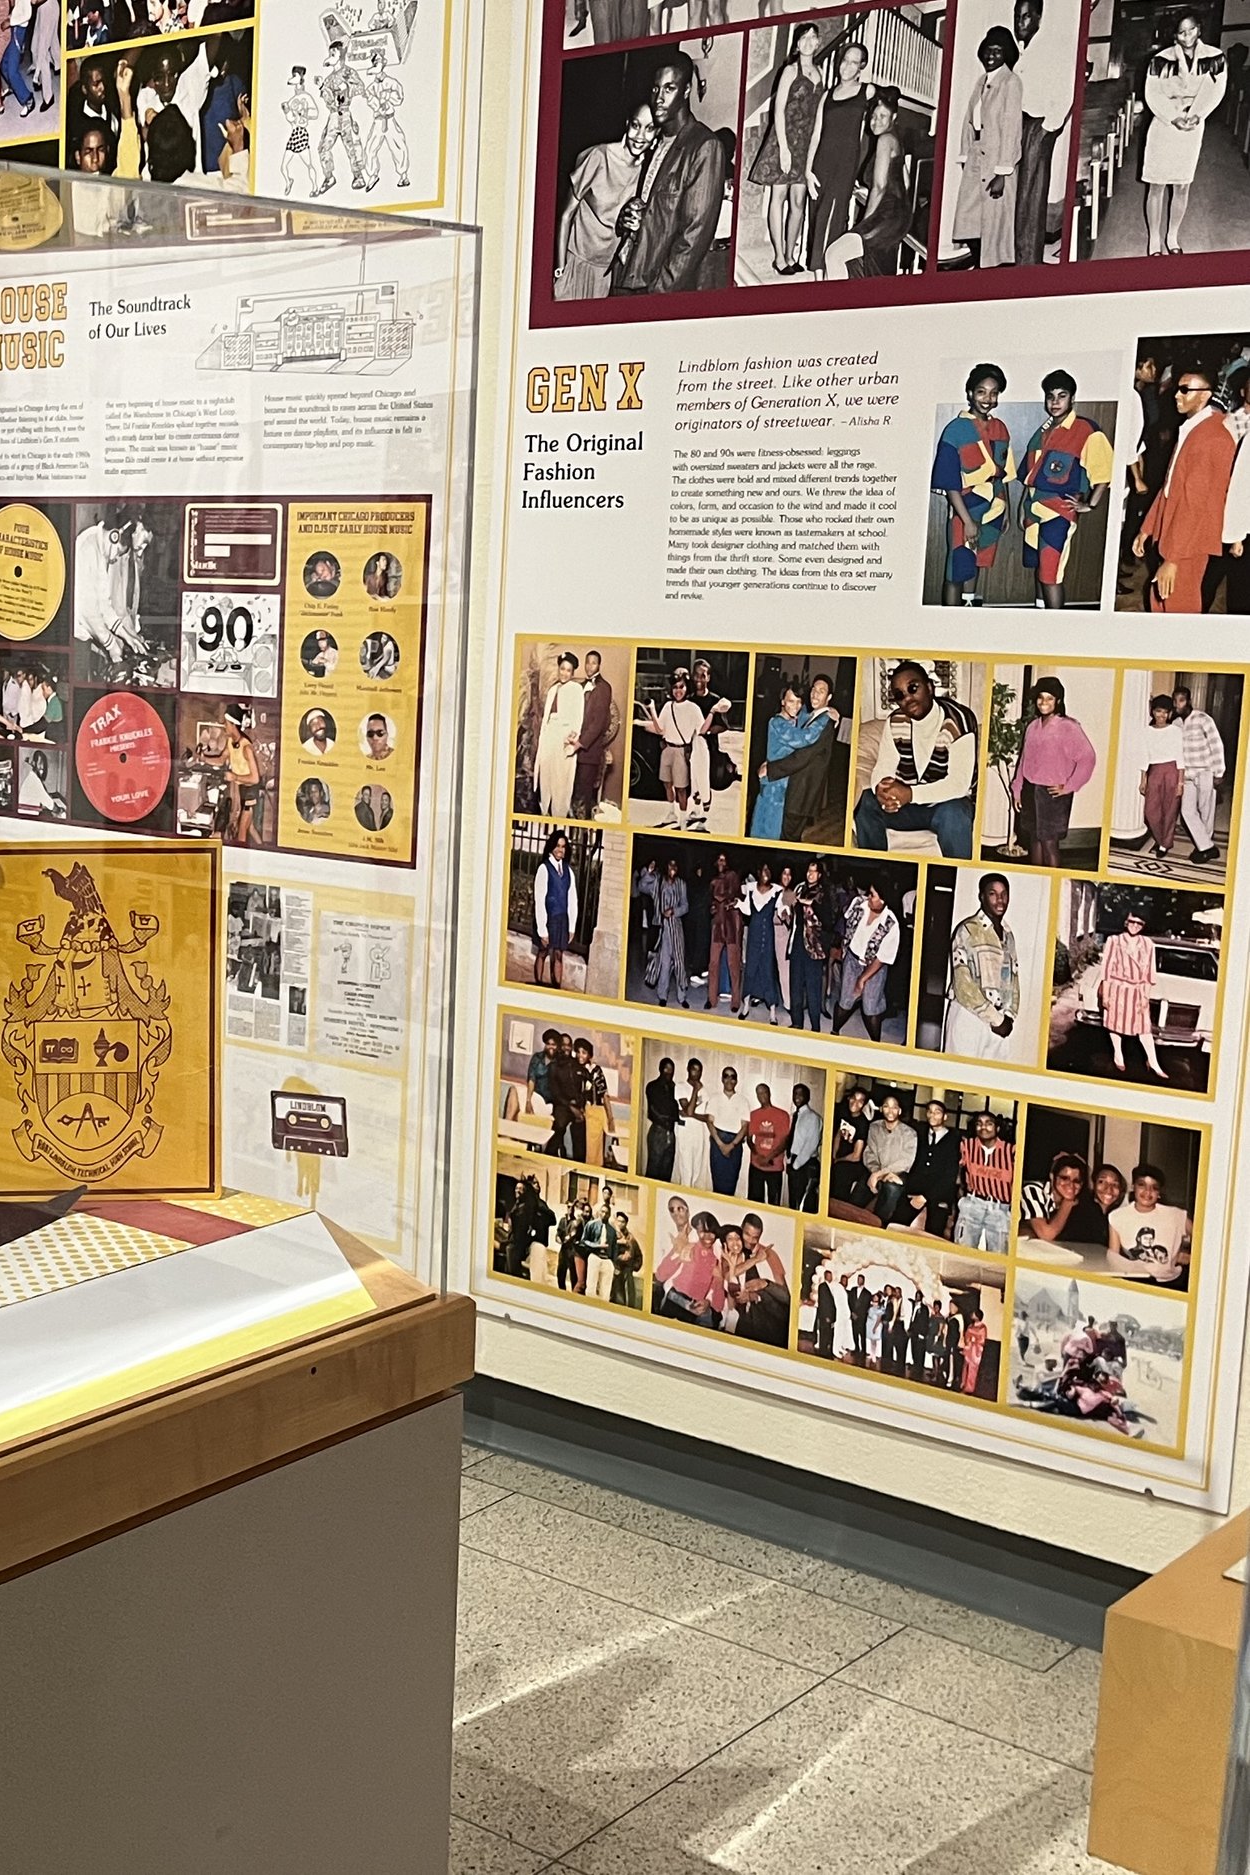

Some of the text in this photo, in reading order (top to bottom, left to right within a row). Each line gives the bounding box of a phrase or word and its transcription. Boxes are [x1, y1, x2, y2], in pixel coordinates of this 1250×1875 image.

[88, 294, 191, 316] The Soundtrack
[88, 321, 167, 340] of Our Lives
[678, 350, 879, 374] Lindblom fashion was created
[526, 361, 645, 413] GEN X
[676, 371, 899, 395] from the street. Like other urban
[676, 393, 900, 412] members of Generation X, we were
[674, 419, 742, 434] originators
[746, 415, 761, 432] of
[524, 431, 643, 454] The Original
[673, 450, 688, 458] The
[690, 449, 702, 458] 80
[703, 448, 718, 458] and
[719, 448, 735, 458] 90s
[826, 446, 861, 458] leggings
[523, 461, 595, 481] Fashion
[672, 475, 687, 484] The
[688, 476, 715, 484] clothes
[737, 474, 754, 484] bold
[755, 474, 771, 484] and
[772, 474, 797, 483] mixed
[798, 474, 832, 483] different
[834, 474, 860, 483] trends
[862, 473, 898, 485] together
[522, 490, 624, 508] Influencers
[705, 488, 745, 499] something
[764, 488, 781, 497] and
[806, 487, 820, 496] We
[822, 487, 847, 496] threw
[848, 487, 863, 496] the
[865, 487, 884, 496] idea
[886, 486, 896, 496] of
[669, 502, 696, 511] colors,
[721, 501, 737, 510] and
[738, 502, 774, 510] occasion
[776, 502, 785, 510] to
[787, 501, 801, 510] the
[802, 501, 824, 510] wind
[825, 501, 842, 510] and
[843, 501, 868, 510] made
[869, 502, 876, 510] it
[878, 500, 898, 510] cool
[198, 606, 253, 652] 90
[89, 704, 122, 735] TRAX
[111, 789, 150, 803] YOUR LOVE
[290, 1101, 326, 1112] LINDBLOM
[76, 1165, 110, 1177] TECHNICAL
